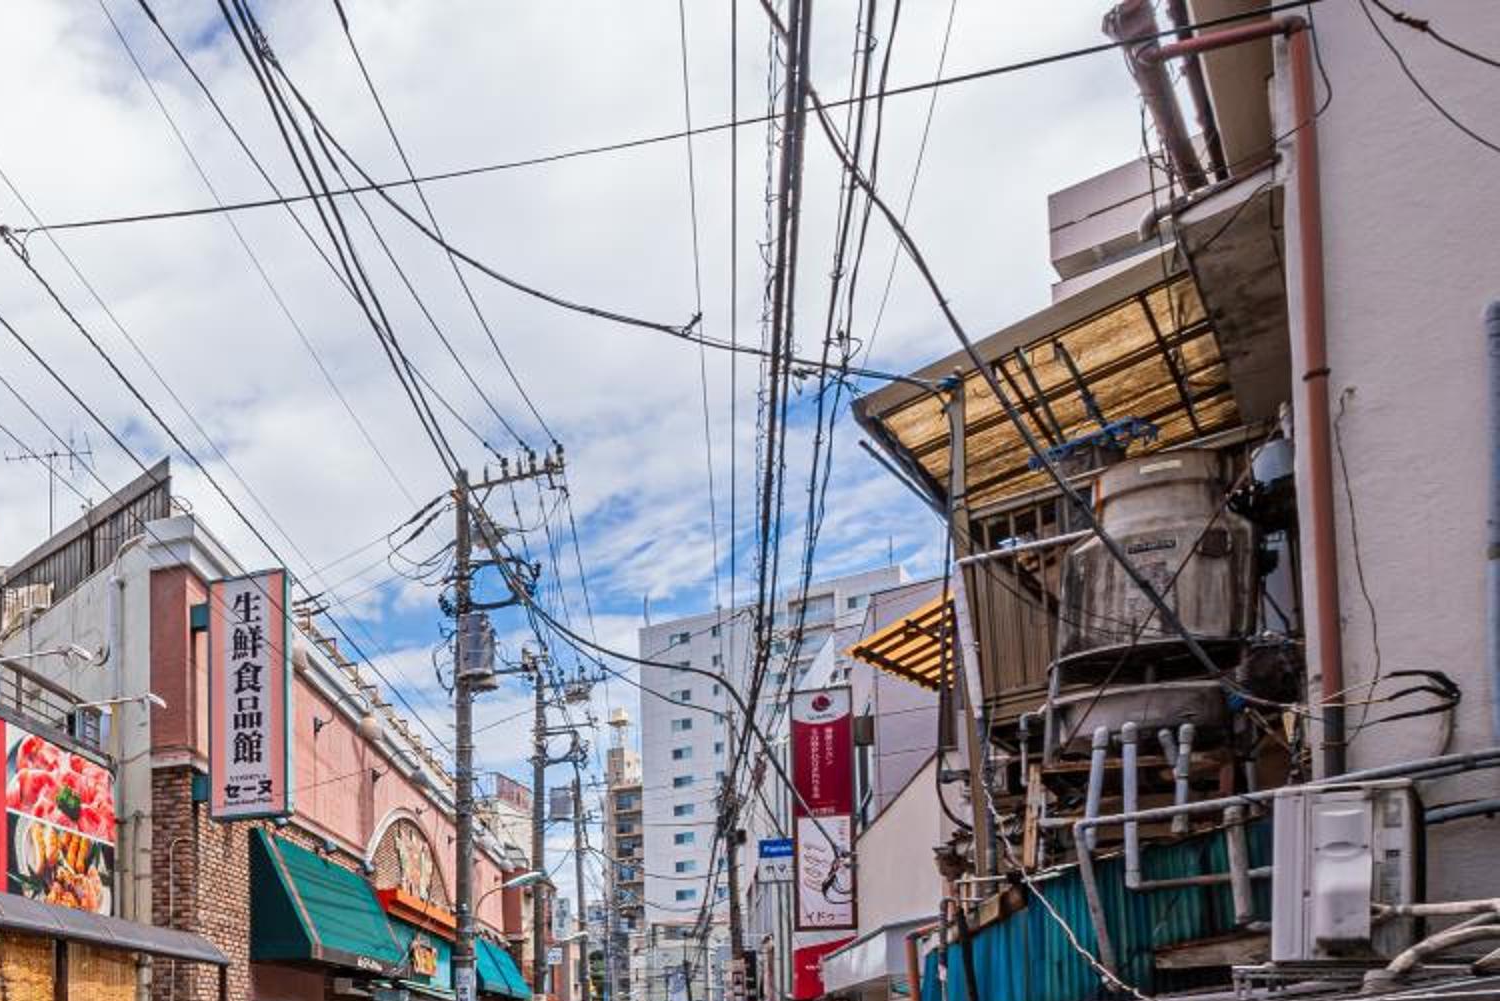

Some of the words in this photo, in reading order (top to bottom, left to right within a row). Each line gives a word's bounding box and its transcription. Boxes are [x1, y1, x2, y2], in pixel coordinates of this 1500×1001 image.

[231, 591, 263, 765] 生鮮食品館
[224, 779, 273, 799] セーヌ
